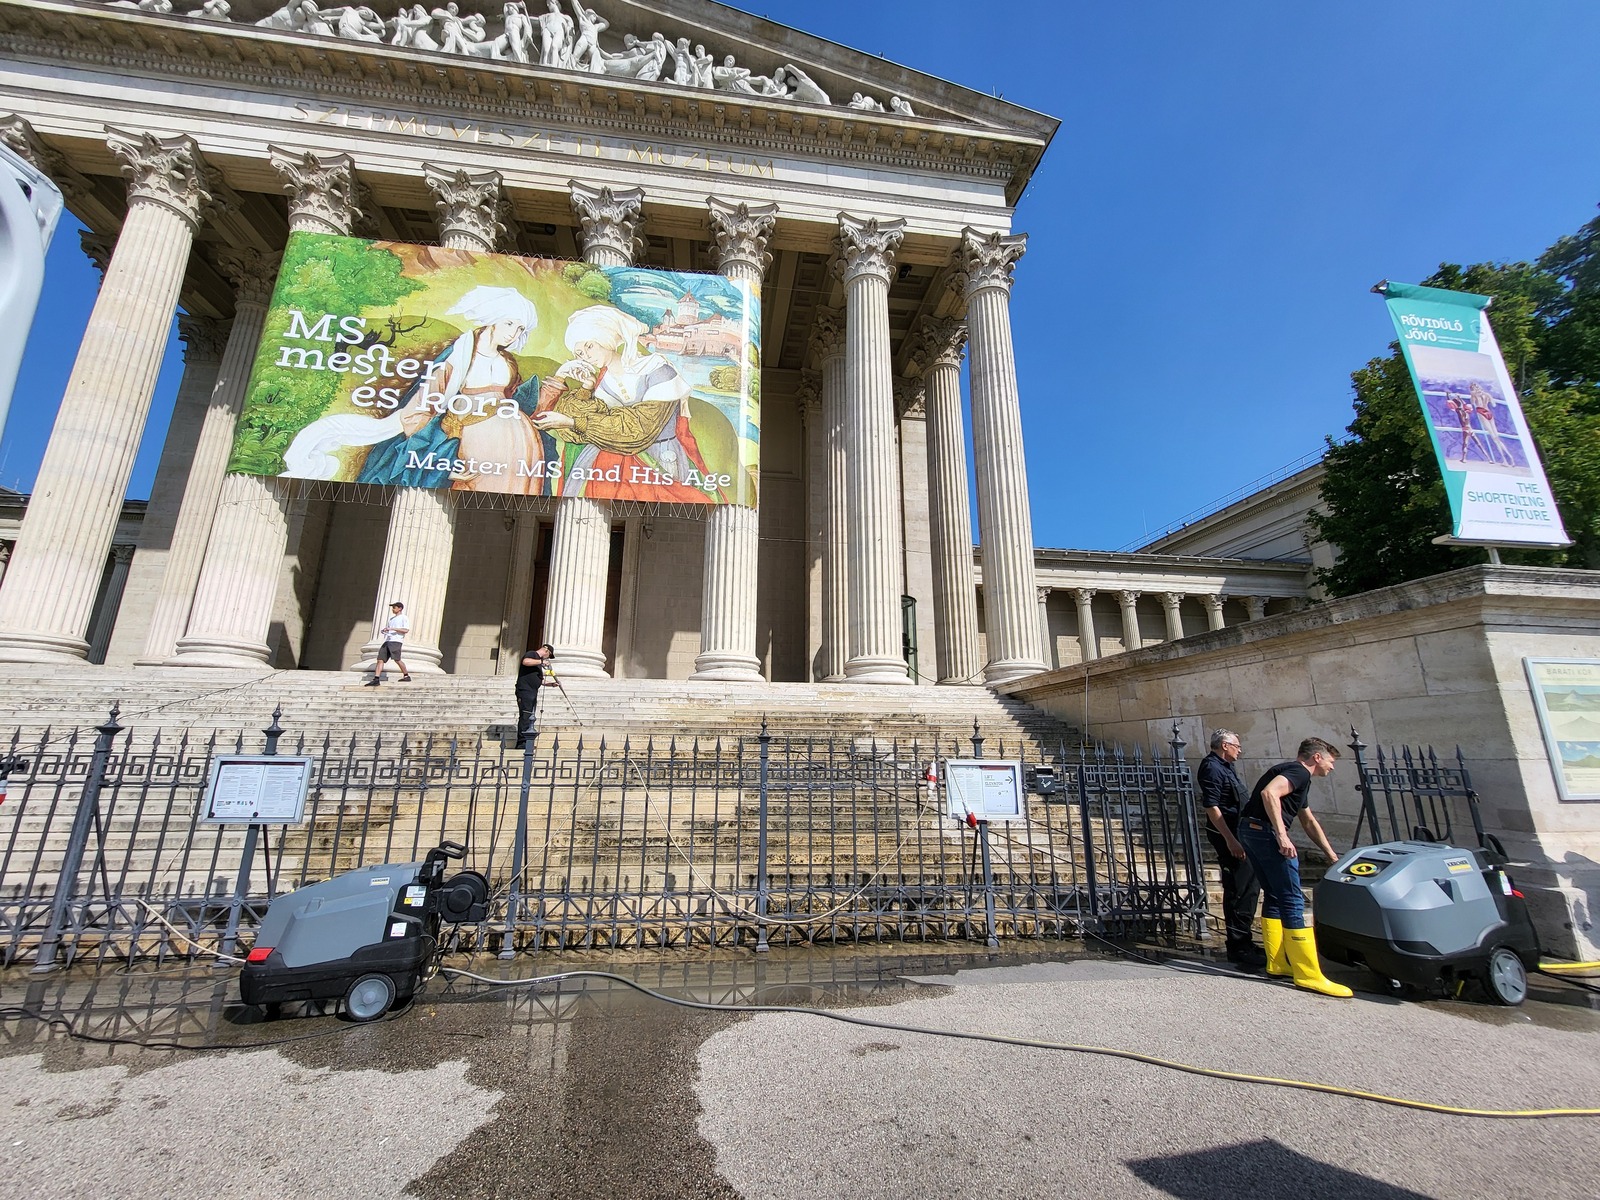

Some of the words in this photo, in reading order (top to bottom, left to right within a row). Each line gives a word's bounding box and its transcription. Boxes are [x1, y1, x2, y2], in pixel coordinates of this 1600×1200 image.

[282, 310, 367, 345] MS
[275, 343, 446, 381] mester
[351, 376, 400, 410] és
[415, 382, 522, 421] kora
[405, 450, 508, 476] Master
[516, 459, 563, 479] MS
[571, 461, 622, 483] and
[629, 465, 674, 486] His
[681, 469, 731, 496] Age
[1516, 482, 1541, 494] THE
[1467, 490, 1546, 508] SHORTENING
[1504, 507, 1551, 522] FUTURE
